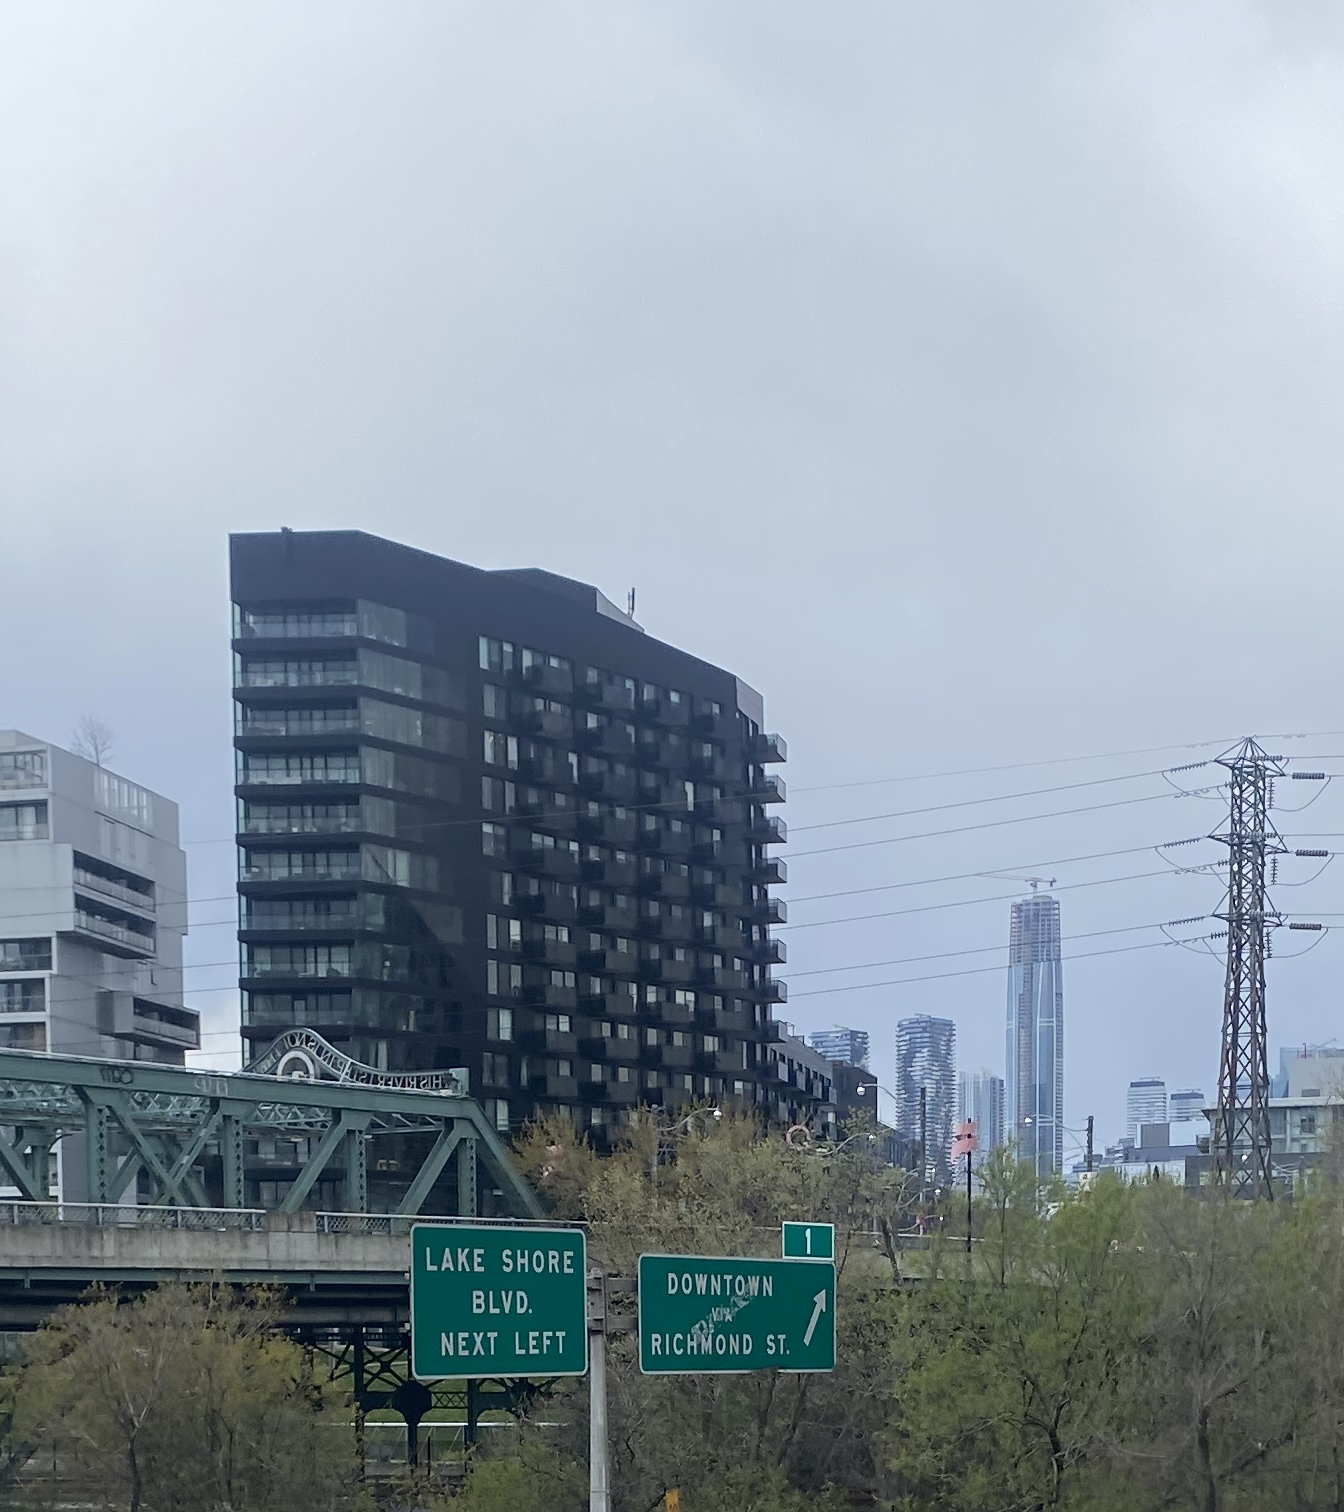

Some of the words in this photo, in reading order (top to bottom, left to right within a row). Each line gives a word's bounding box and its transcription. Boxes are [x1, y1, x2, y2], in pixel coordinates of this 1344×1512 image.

[805, 1228, 812, 1255] 1
[425, 1246, 485, 1272] LAKE
[501, 1249, 574, 1274] SHORE
[667, 1272, 773, 1297] DOWNTOWN
[472, 1290, 533, 1314] BLVD.
[441, 1331, 498, 1356] NEXT
[515, 1331, 566, 1355] LEFT
[651, 1333, 753, 1355] RICHMOND
[766, 1333, 790, 1355] ST.
